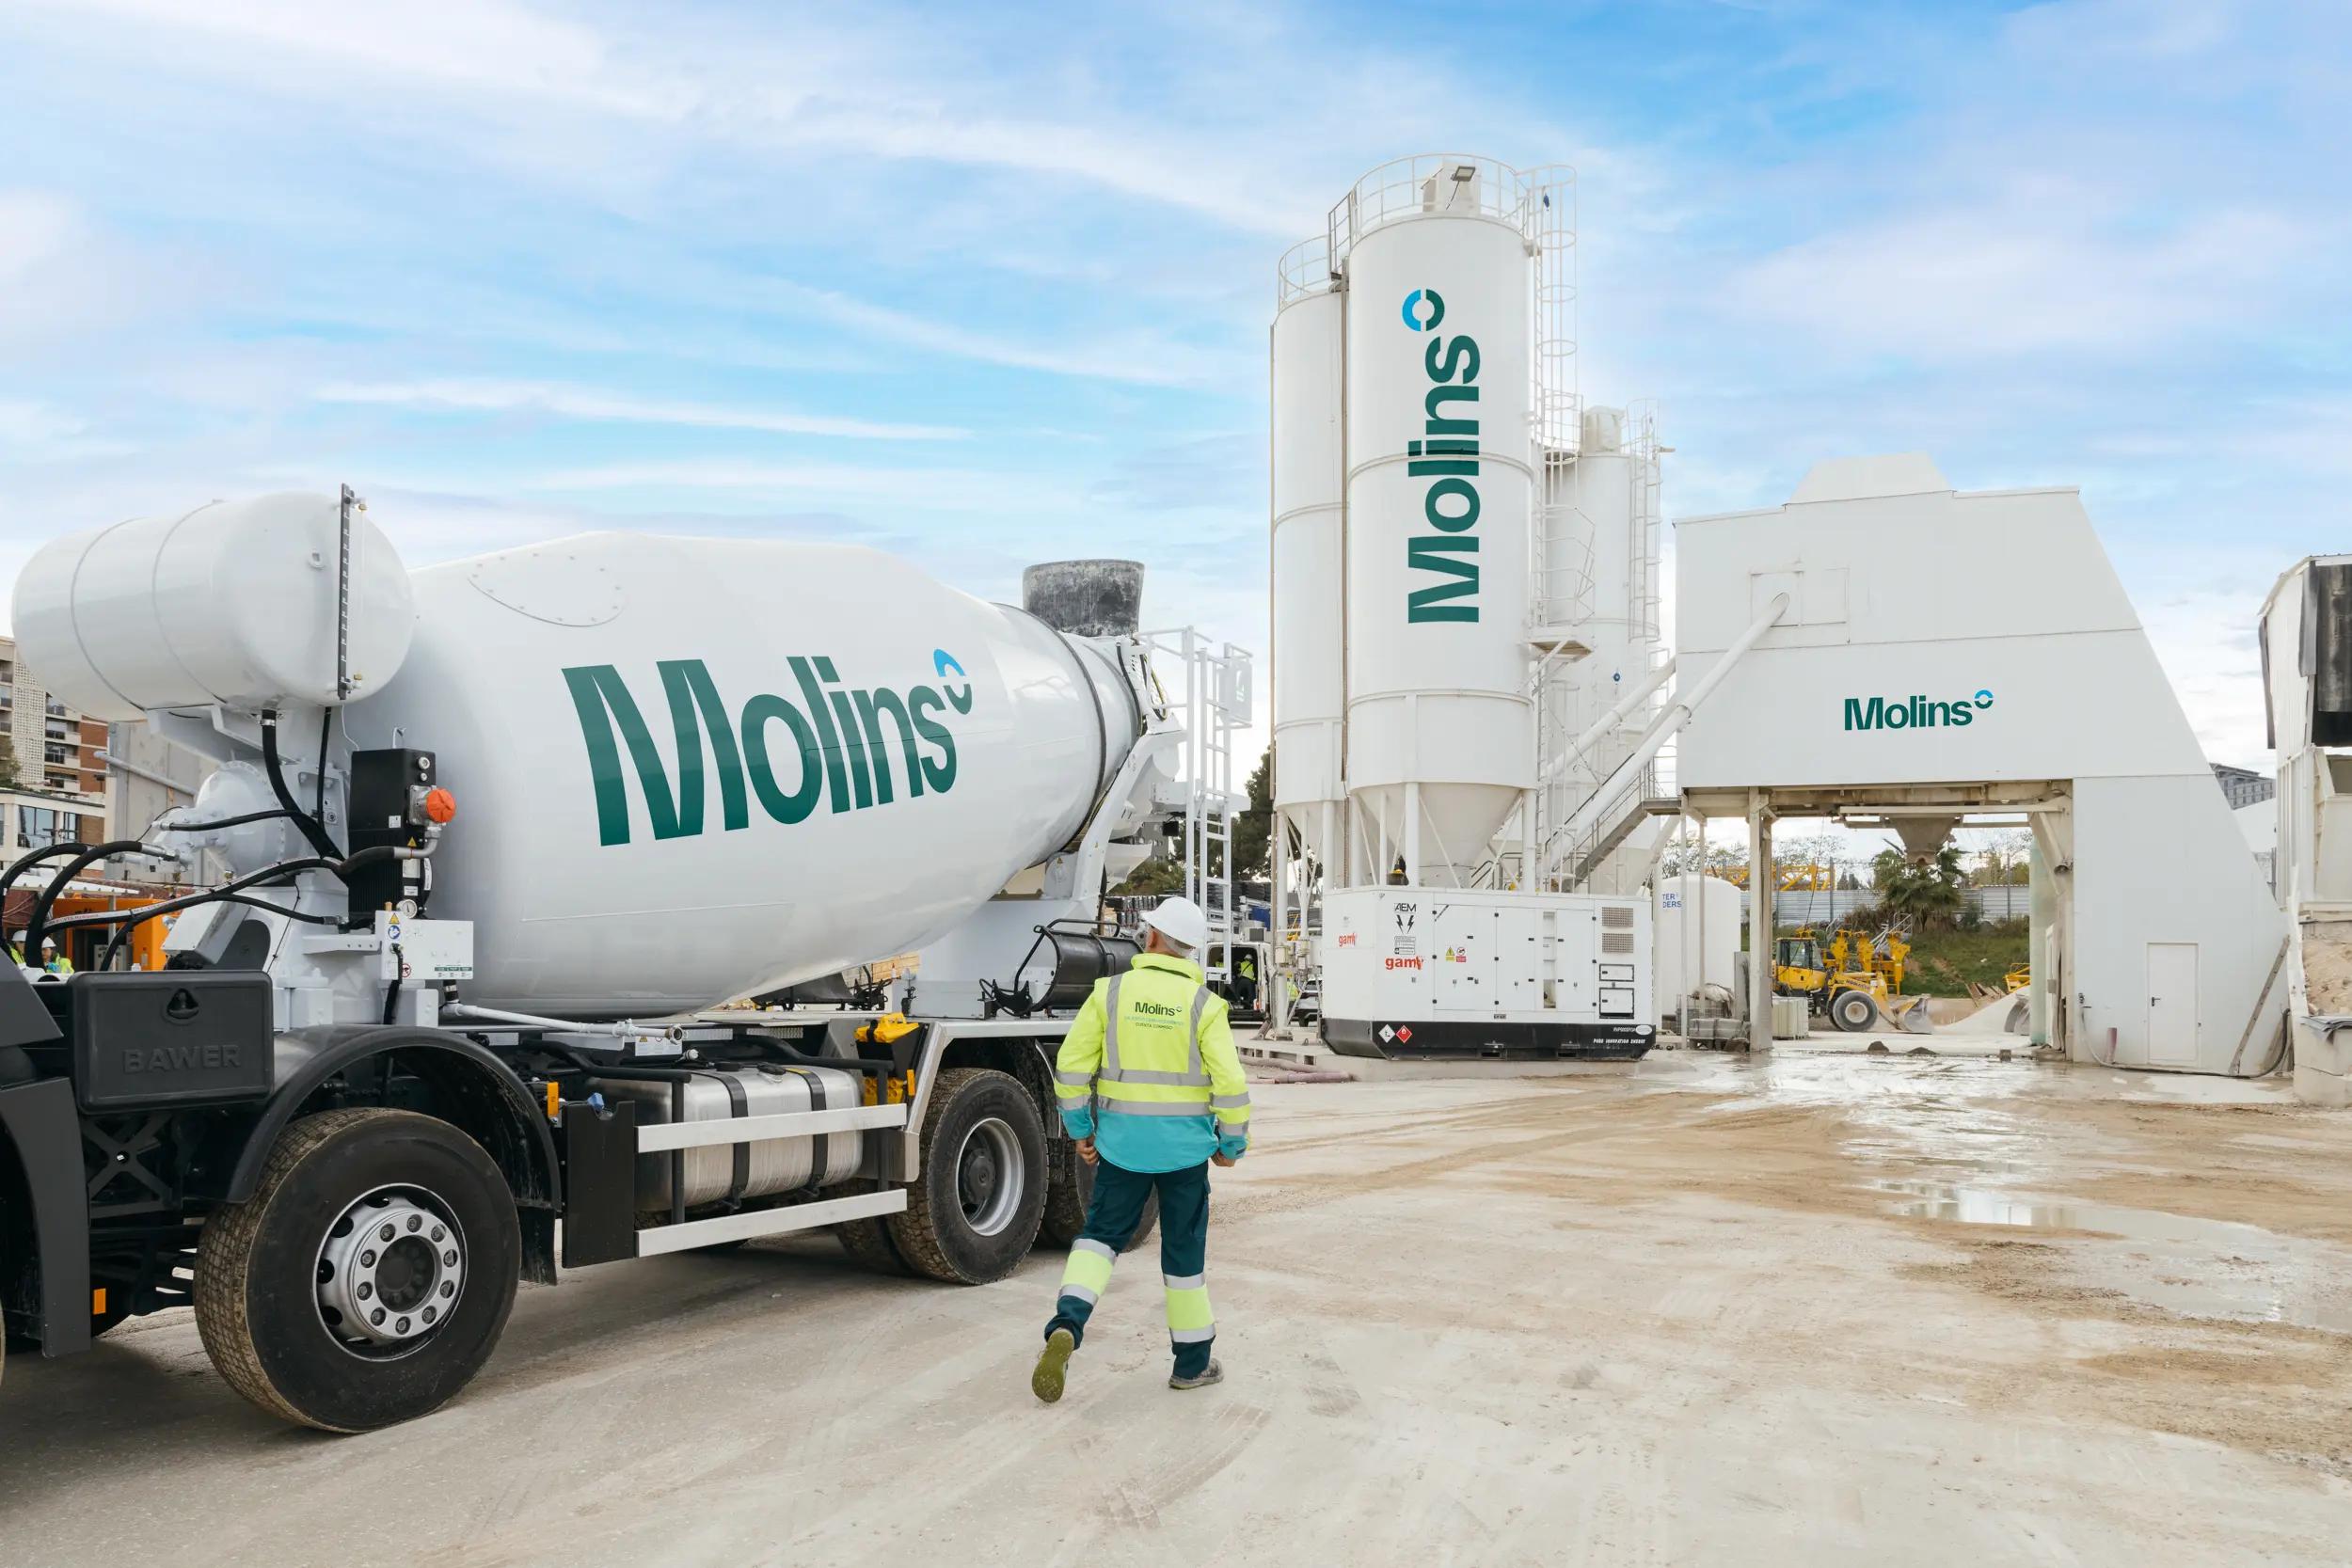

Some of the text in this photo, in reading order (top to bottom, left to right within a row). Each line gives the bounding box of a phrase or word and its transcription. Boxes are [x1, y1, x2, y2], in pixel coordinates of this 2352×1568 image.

[1408, 335, 1481, 624] Molins
[1845, 695, 1973, 731] Molins
[561, 656, 957, 847] Molins
[1135, 1002, 1175, 1017] Molins
[122, 1044, 242, 1074] BAWER
